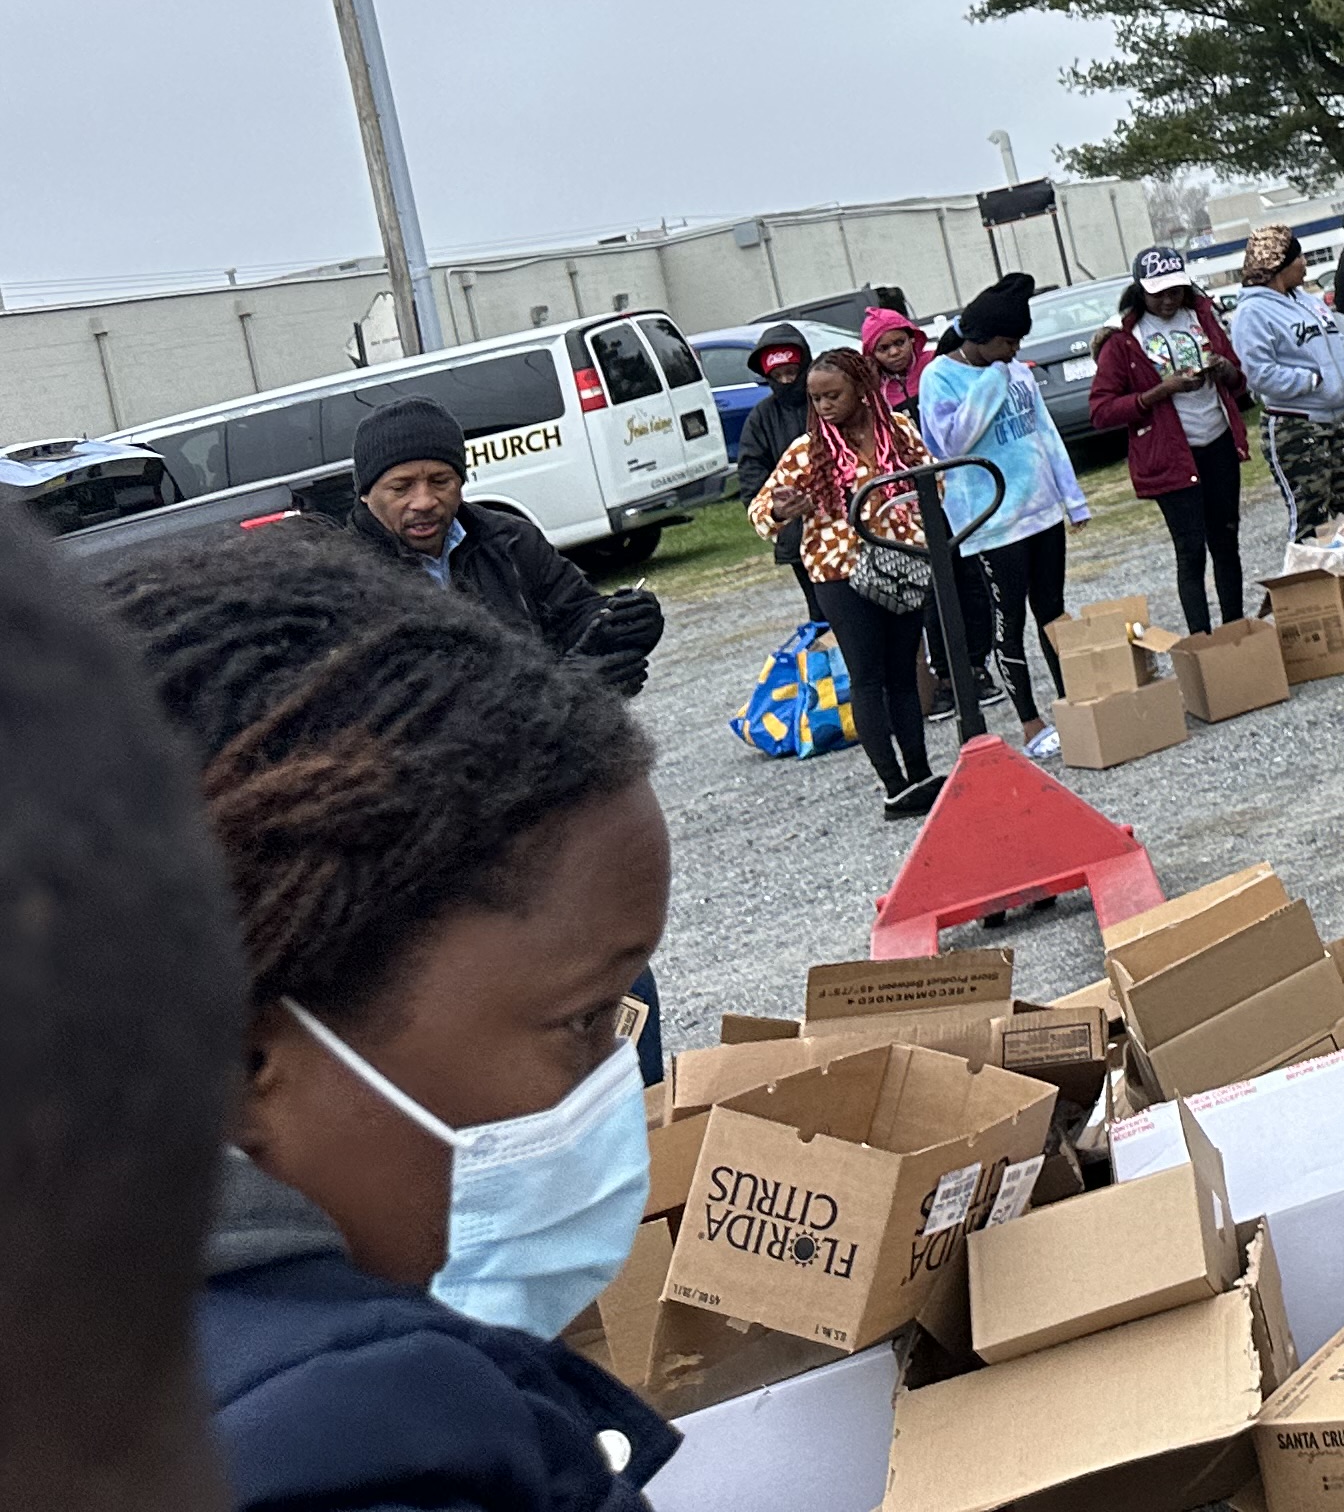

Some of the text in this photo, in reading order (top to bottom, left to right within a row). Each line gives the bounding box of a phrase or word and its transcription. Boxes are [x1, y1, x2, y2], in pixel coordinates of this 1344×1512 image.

[1141, 250, 1182, 279] Boss
[464, 425, 562, 468] HURCH
[926, 974, 969, 986] Product
[819, 988, 827, 999] F
[858, 987, 965, 1006] RECOMMENDED
[708, 1166, 838, 1231] CITRUS
[705, 1203, 860, 1280] FLORIDA
[1277, 1431, 1320, 1451] SANTA
